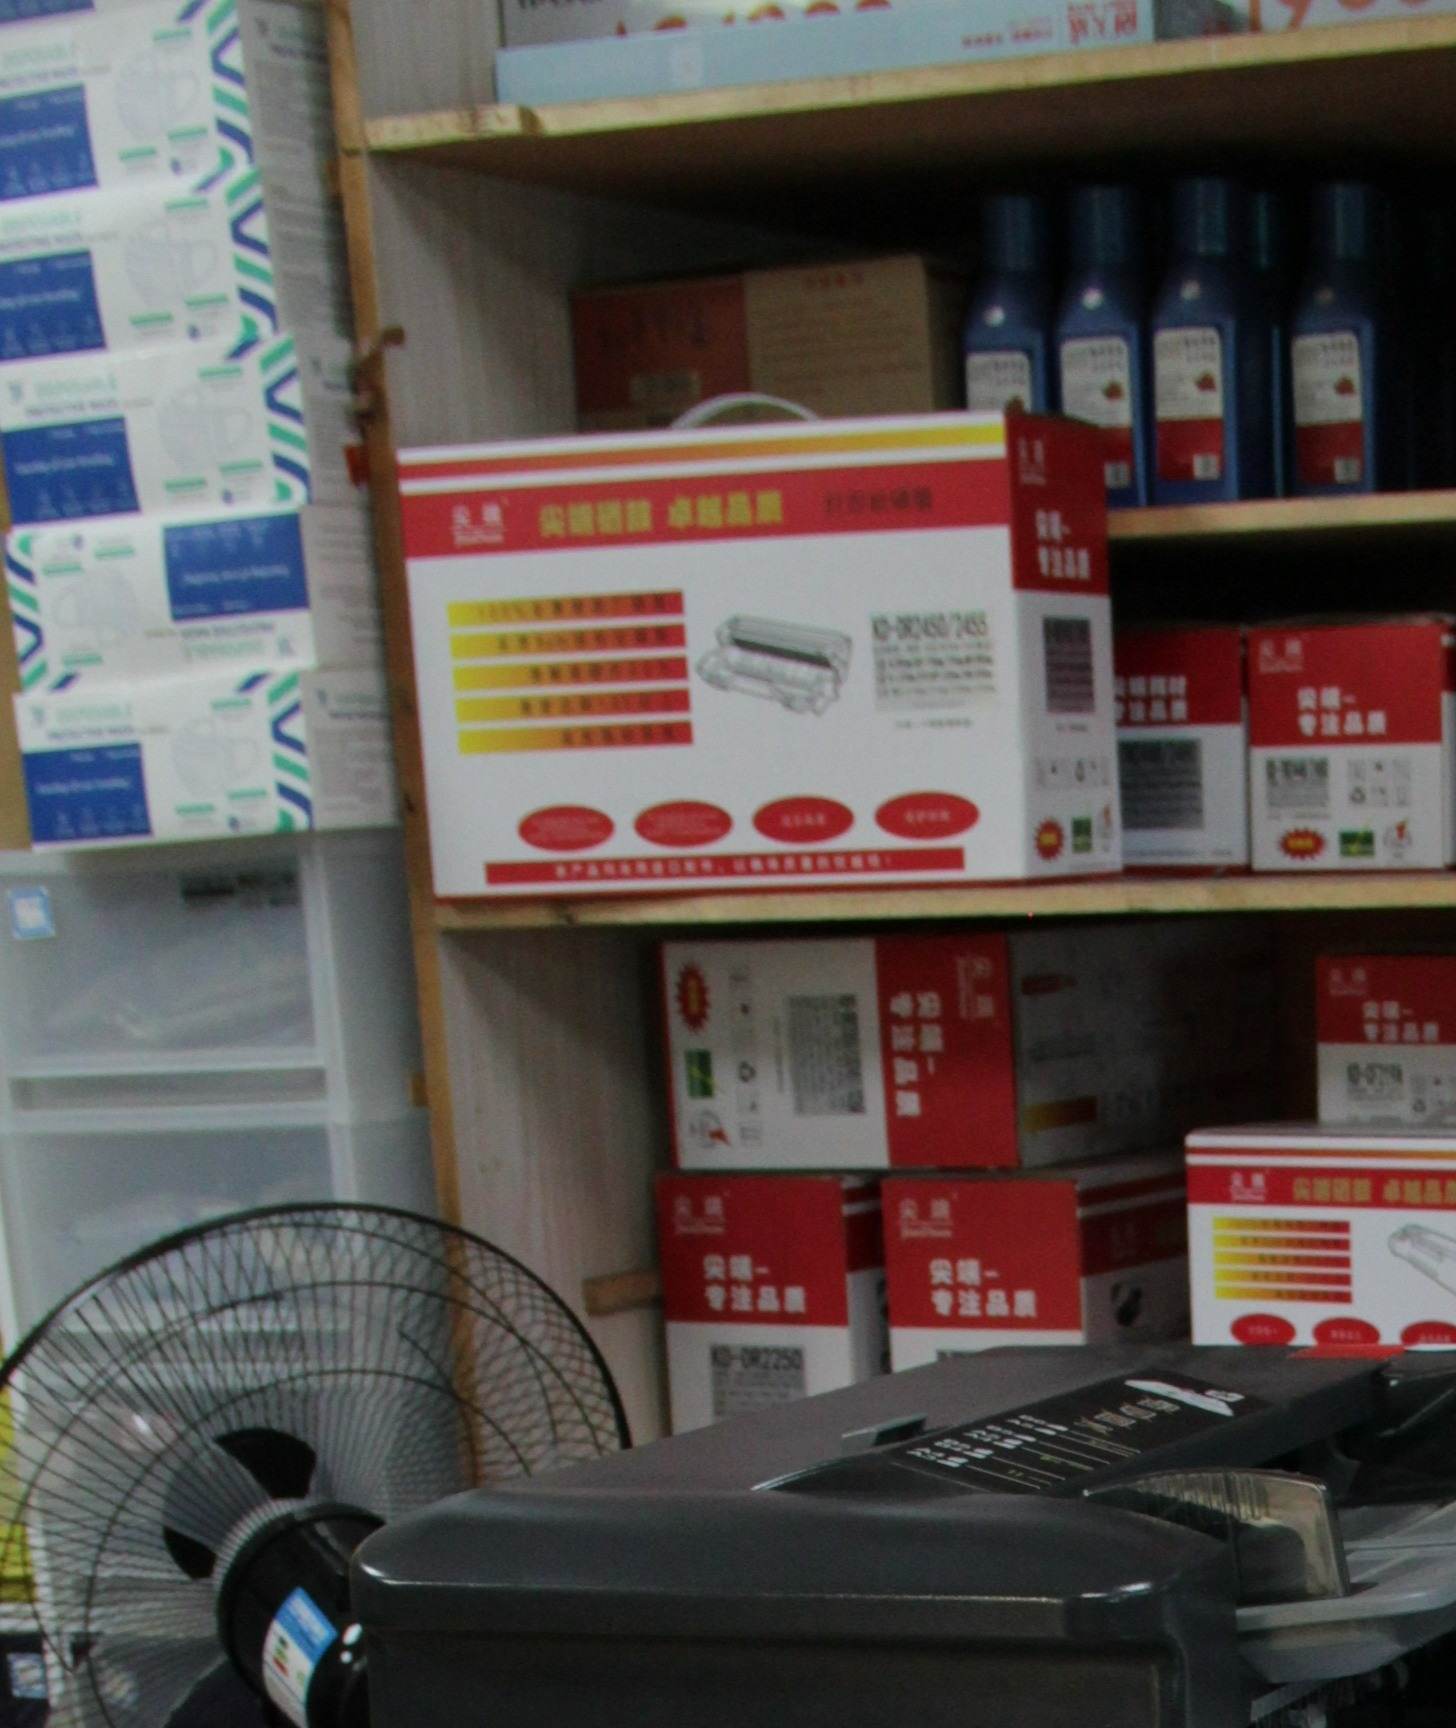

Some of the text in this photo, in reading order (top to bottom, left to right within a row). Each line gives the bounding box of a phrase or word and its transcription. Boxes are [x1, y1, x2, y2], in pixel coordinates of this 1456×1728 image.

[704, 1285, 806, 1313] 专注品质
[931, 1287, 1038, 1319] 专注品质
